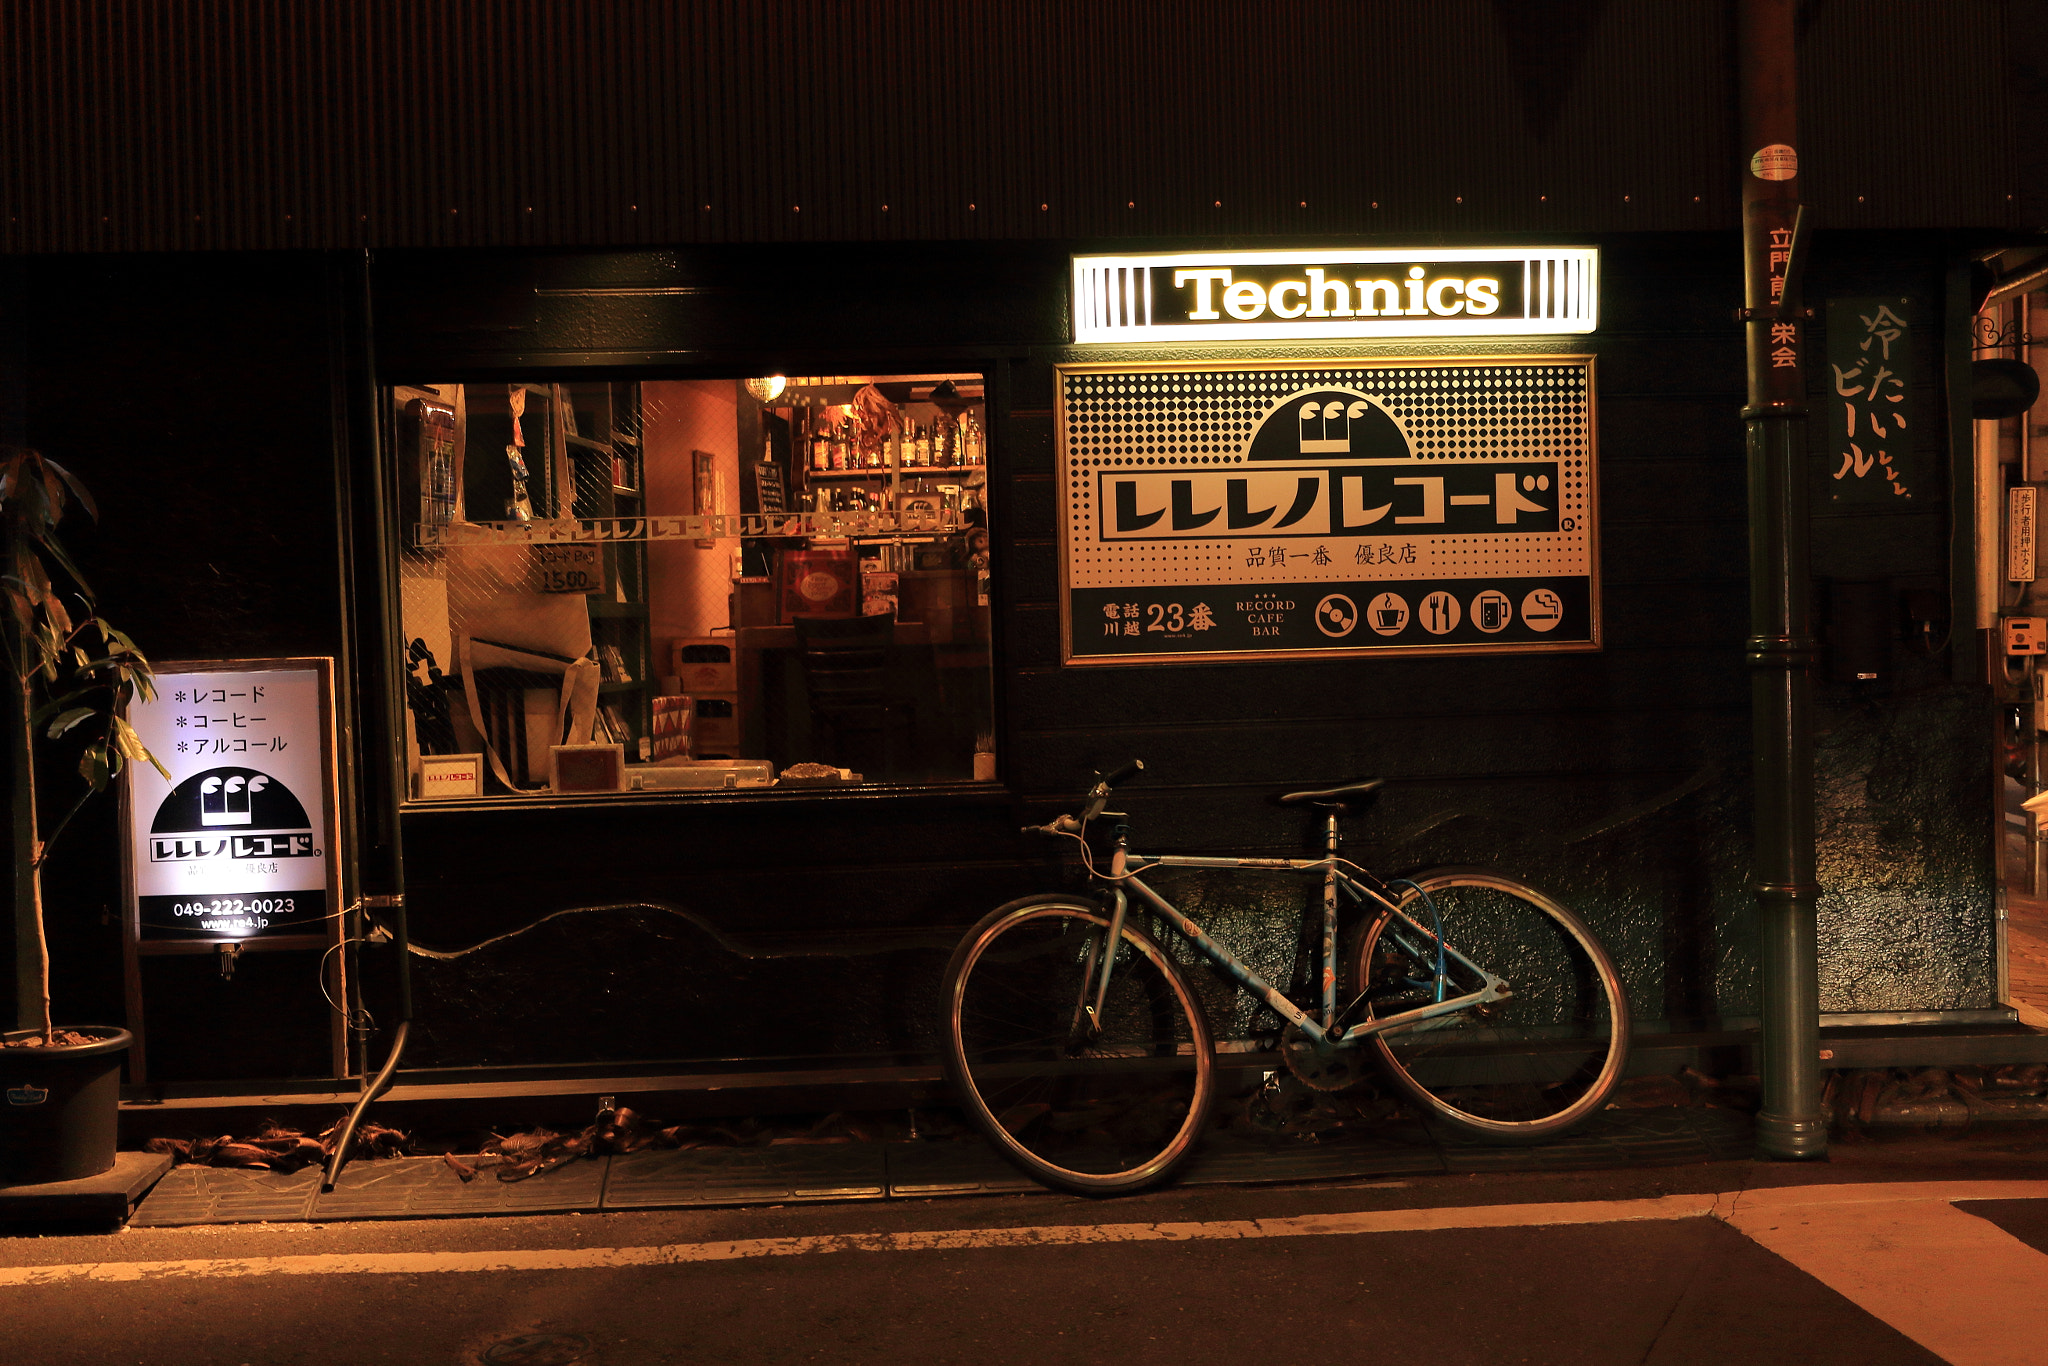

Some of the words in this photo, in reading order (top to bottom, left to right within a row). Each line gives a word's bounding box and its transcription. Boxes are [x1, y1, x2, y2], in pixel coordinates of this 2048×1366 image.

[1174, 266, 1500, 320] Technics
[1859, 305, 1908, 439] 冷たい
[1831, 357, 1874, 480] ビール
[1246, 545, 1333, 567] 品質一番
[1354, 543, 1417, 565] 優良店
[1103, 602, 1140, 619] 電話
[1235, 600, 1296, 612] RECORD
[1247, 613, 1285, 624] CAFE
[1103, 621, 1141, 637] 川越
[1252, 625, 1281, 637] BAR
[173, 898, 295, 917] 049-222-0023
